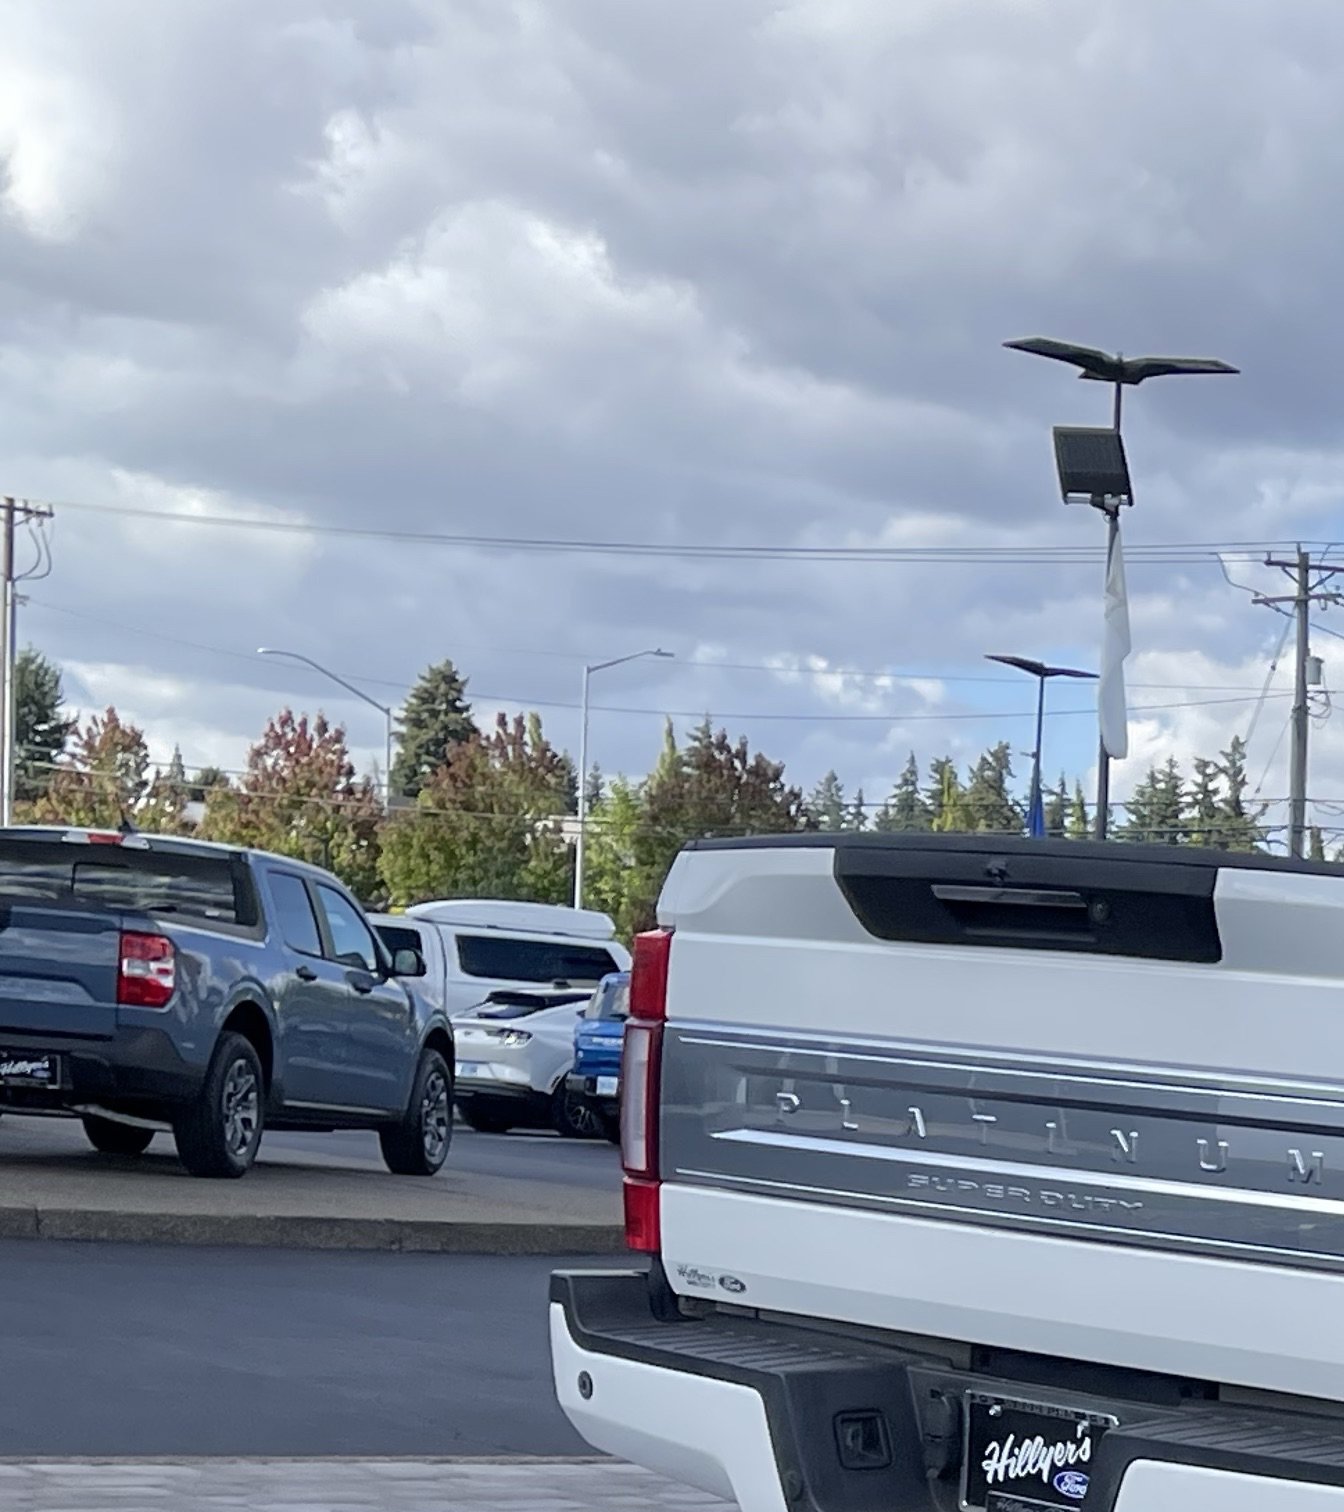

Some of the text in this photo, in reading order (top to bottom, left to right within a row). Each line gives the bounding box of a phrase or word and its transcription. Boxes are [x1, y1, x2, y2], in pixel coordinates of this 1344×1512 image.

[777, 1092, 1325, 1185] PLATINUM
[907, 1174, 1144, 1211] SUPER DUTY
[982, 1422, 1091, 1483] Hillyer's
